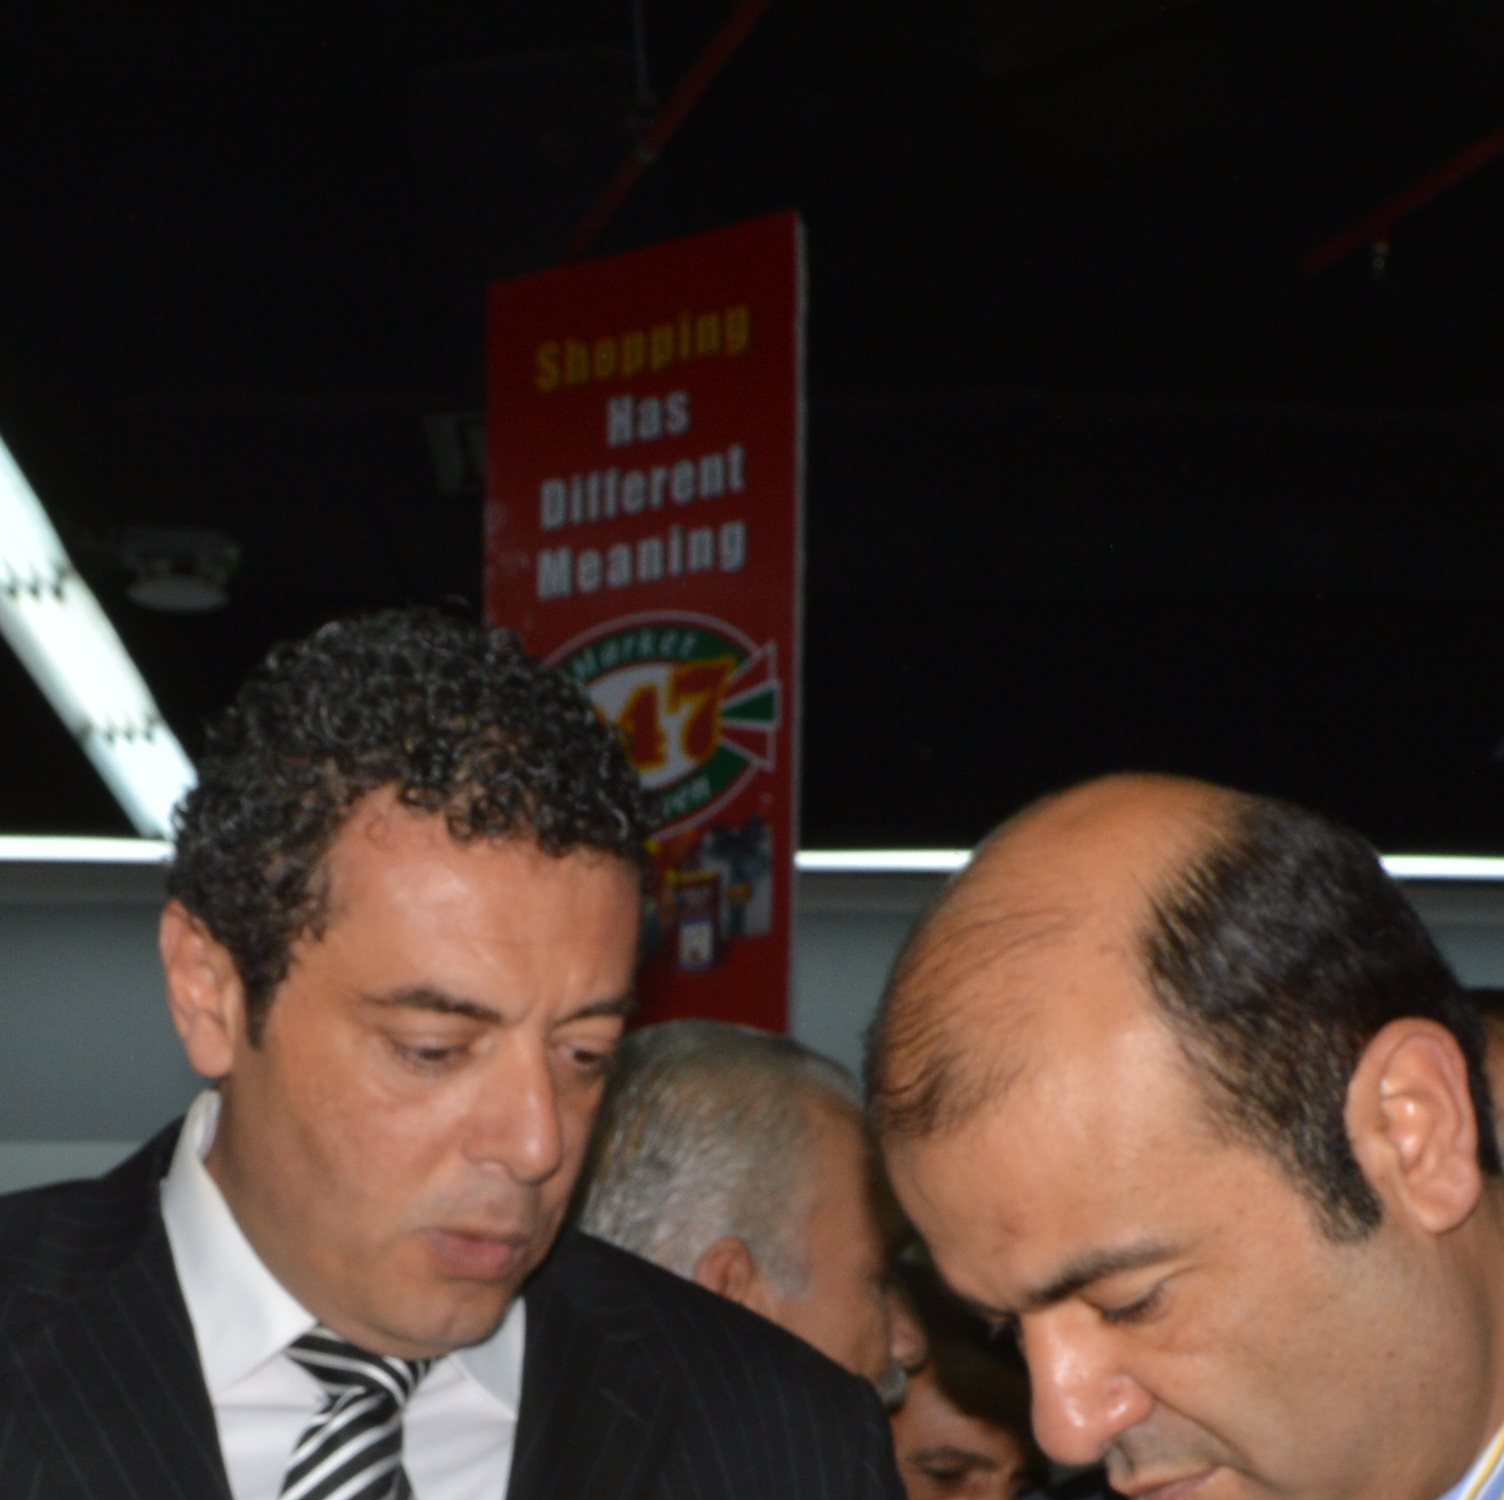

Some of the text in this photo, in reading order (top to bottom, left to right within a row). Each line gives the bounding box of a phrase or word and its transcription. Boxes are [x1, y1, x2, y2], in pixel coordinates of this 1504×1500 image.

[535, 305, 750, 393] Shopping
[606, 390, 691, 449] Has
[539, 442, 746, 532] Different
[536, 519, 748, 601] Meaning
